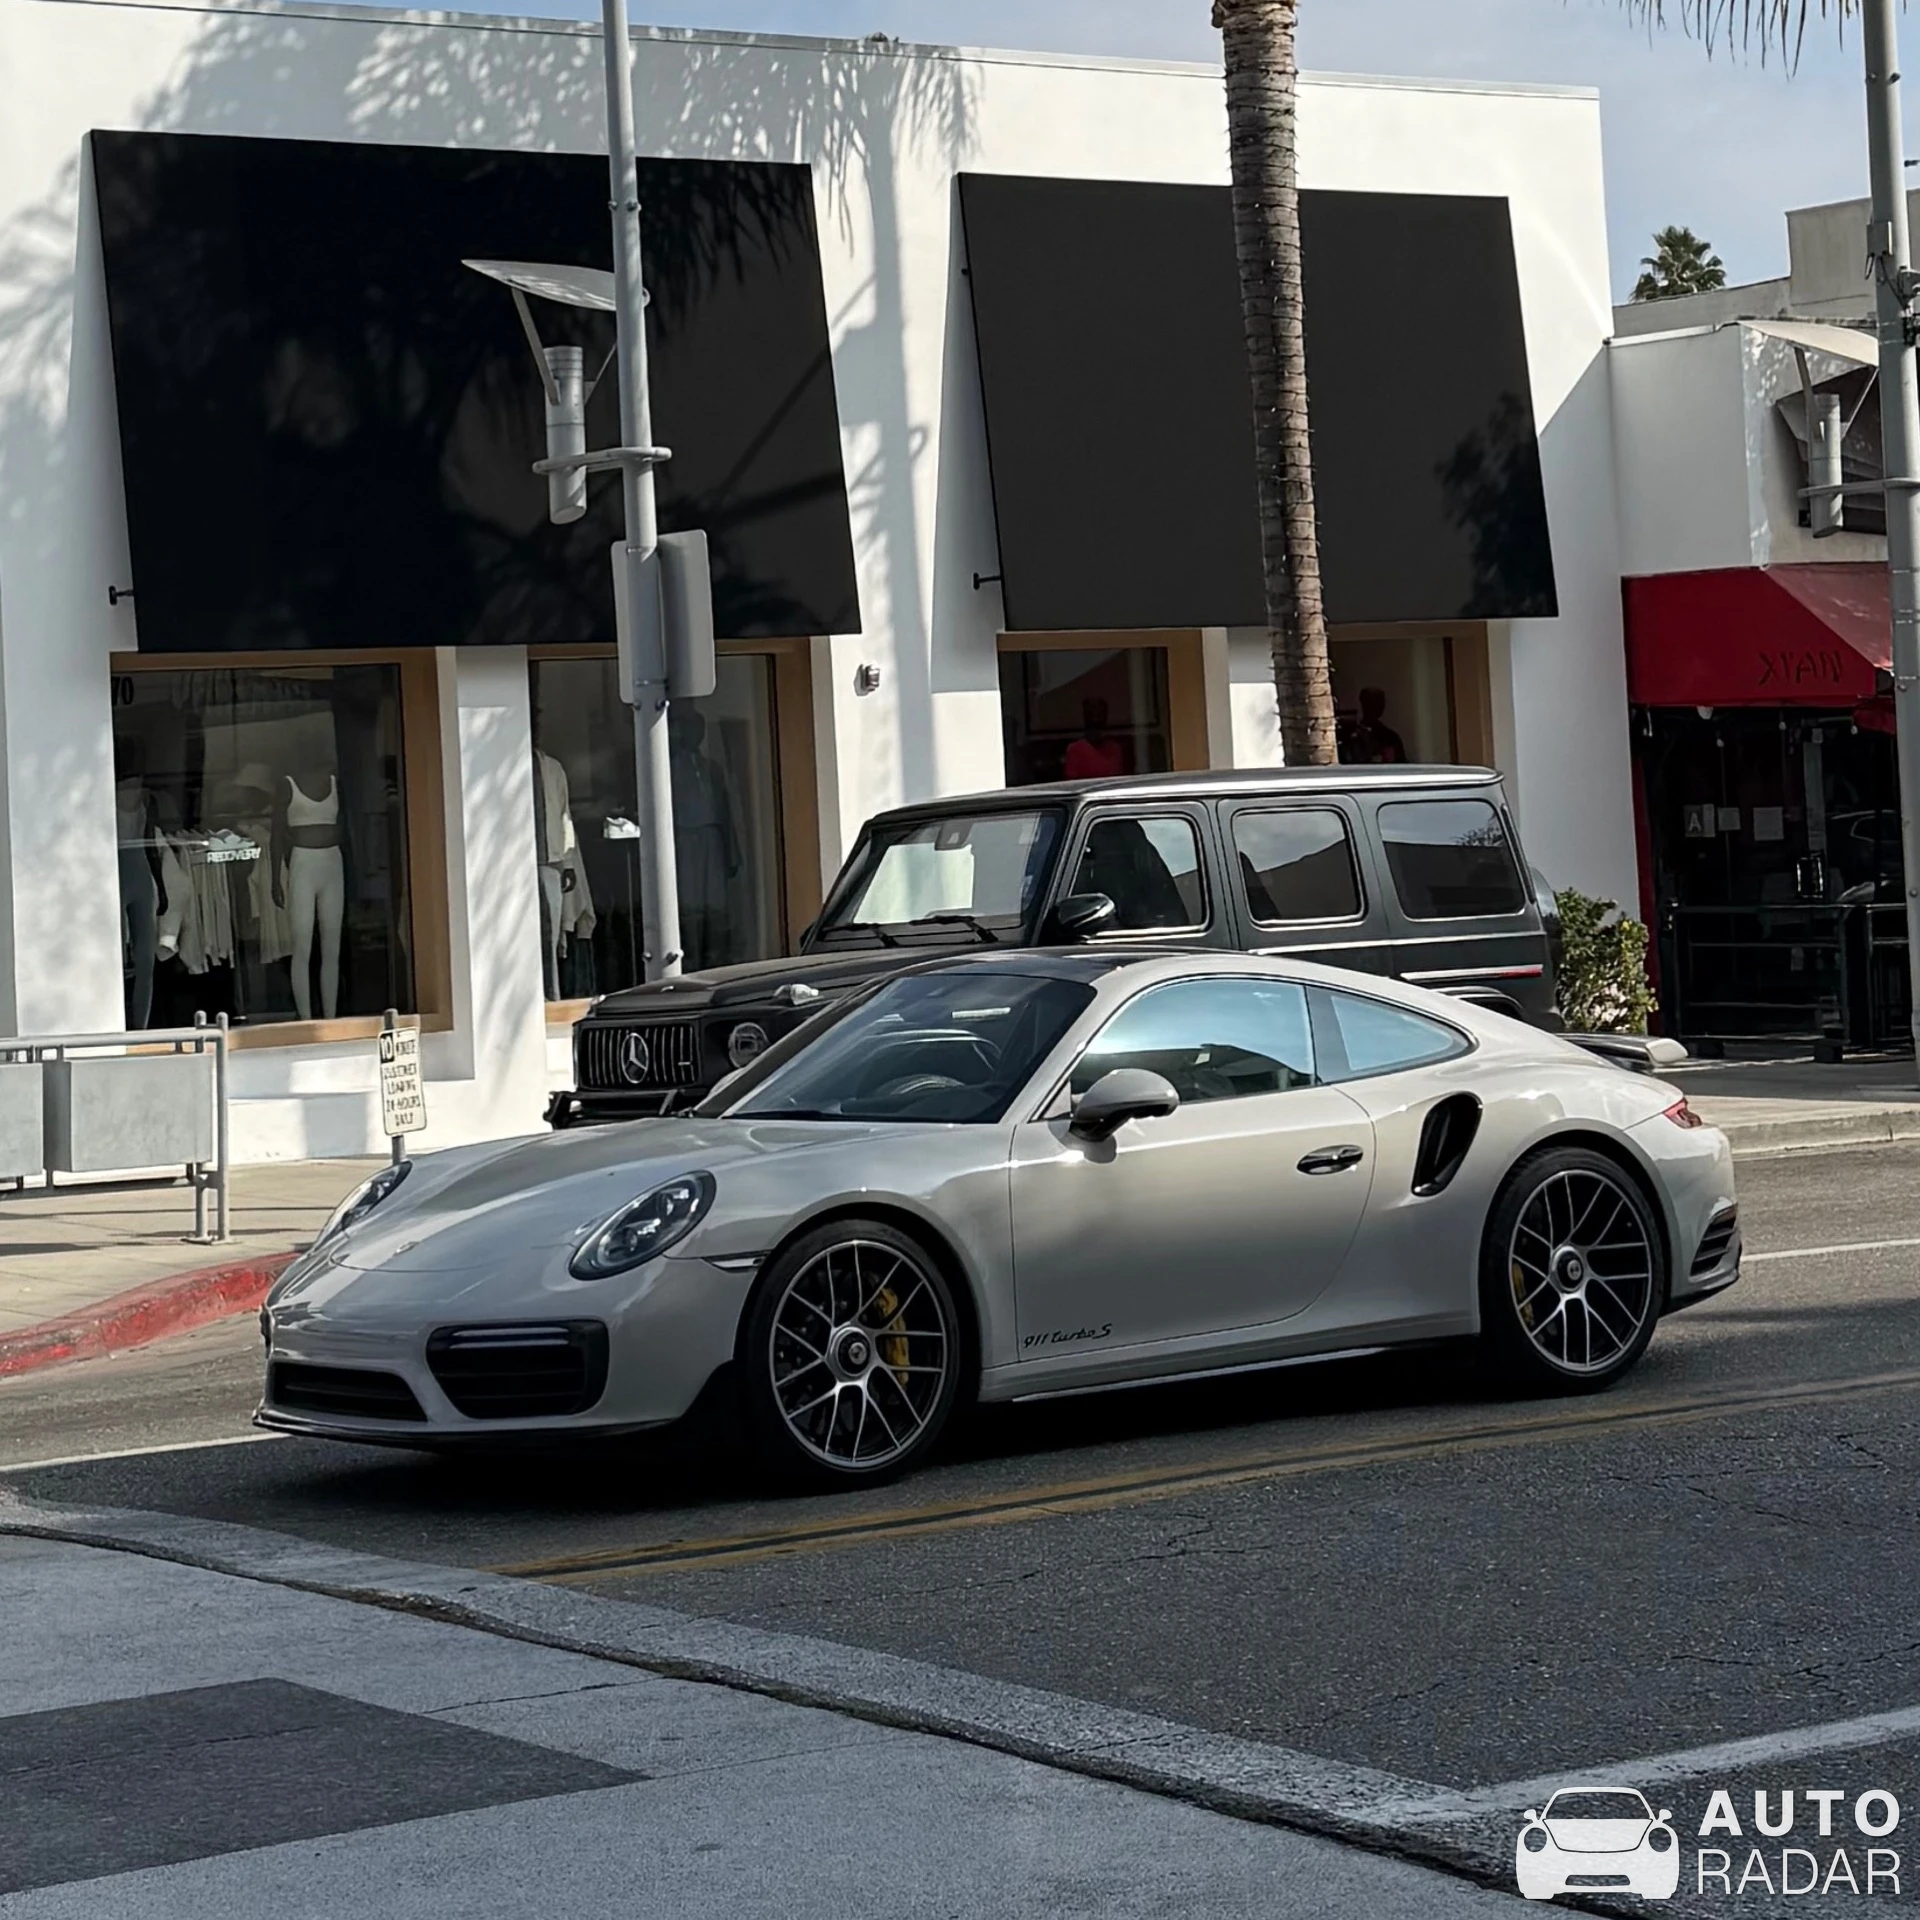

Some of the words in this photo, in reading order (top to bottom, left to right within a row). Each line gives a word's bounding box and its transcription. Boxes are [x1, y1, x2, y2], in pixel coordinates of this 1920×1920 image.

[1687, 811, 1703, 833] A
[381, 1036, 393, 1059] 10
[1024, 1333, 1049, 1348] 911
[1051, 1328, 1096, 1343] turbo
[1092, 1323, 1112, 1339] S
